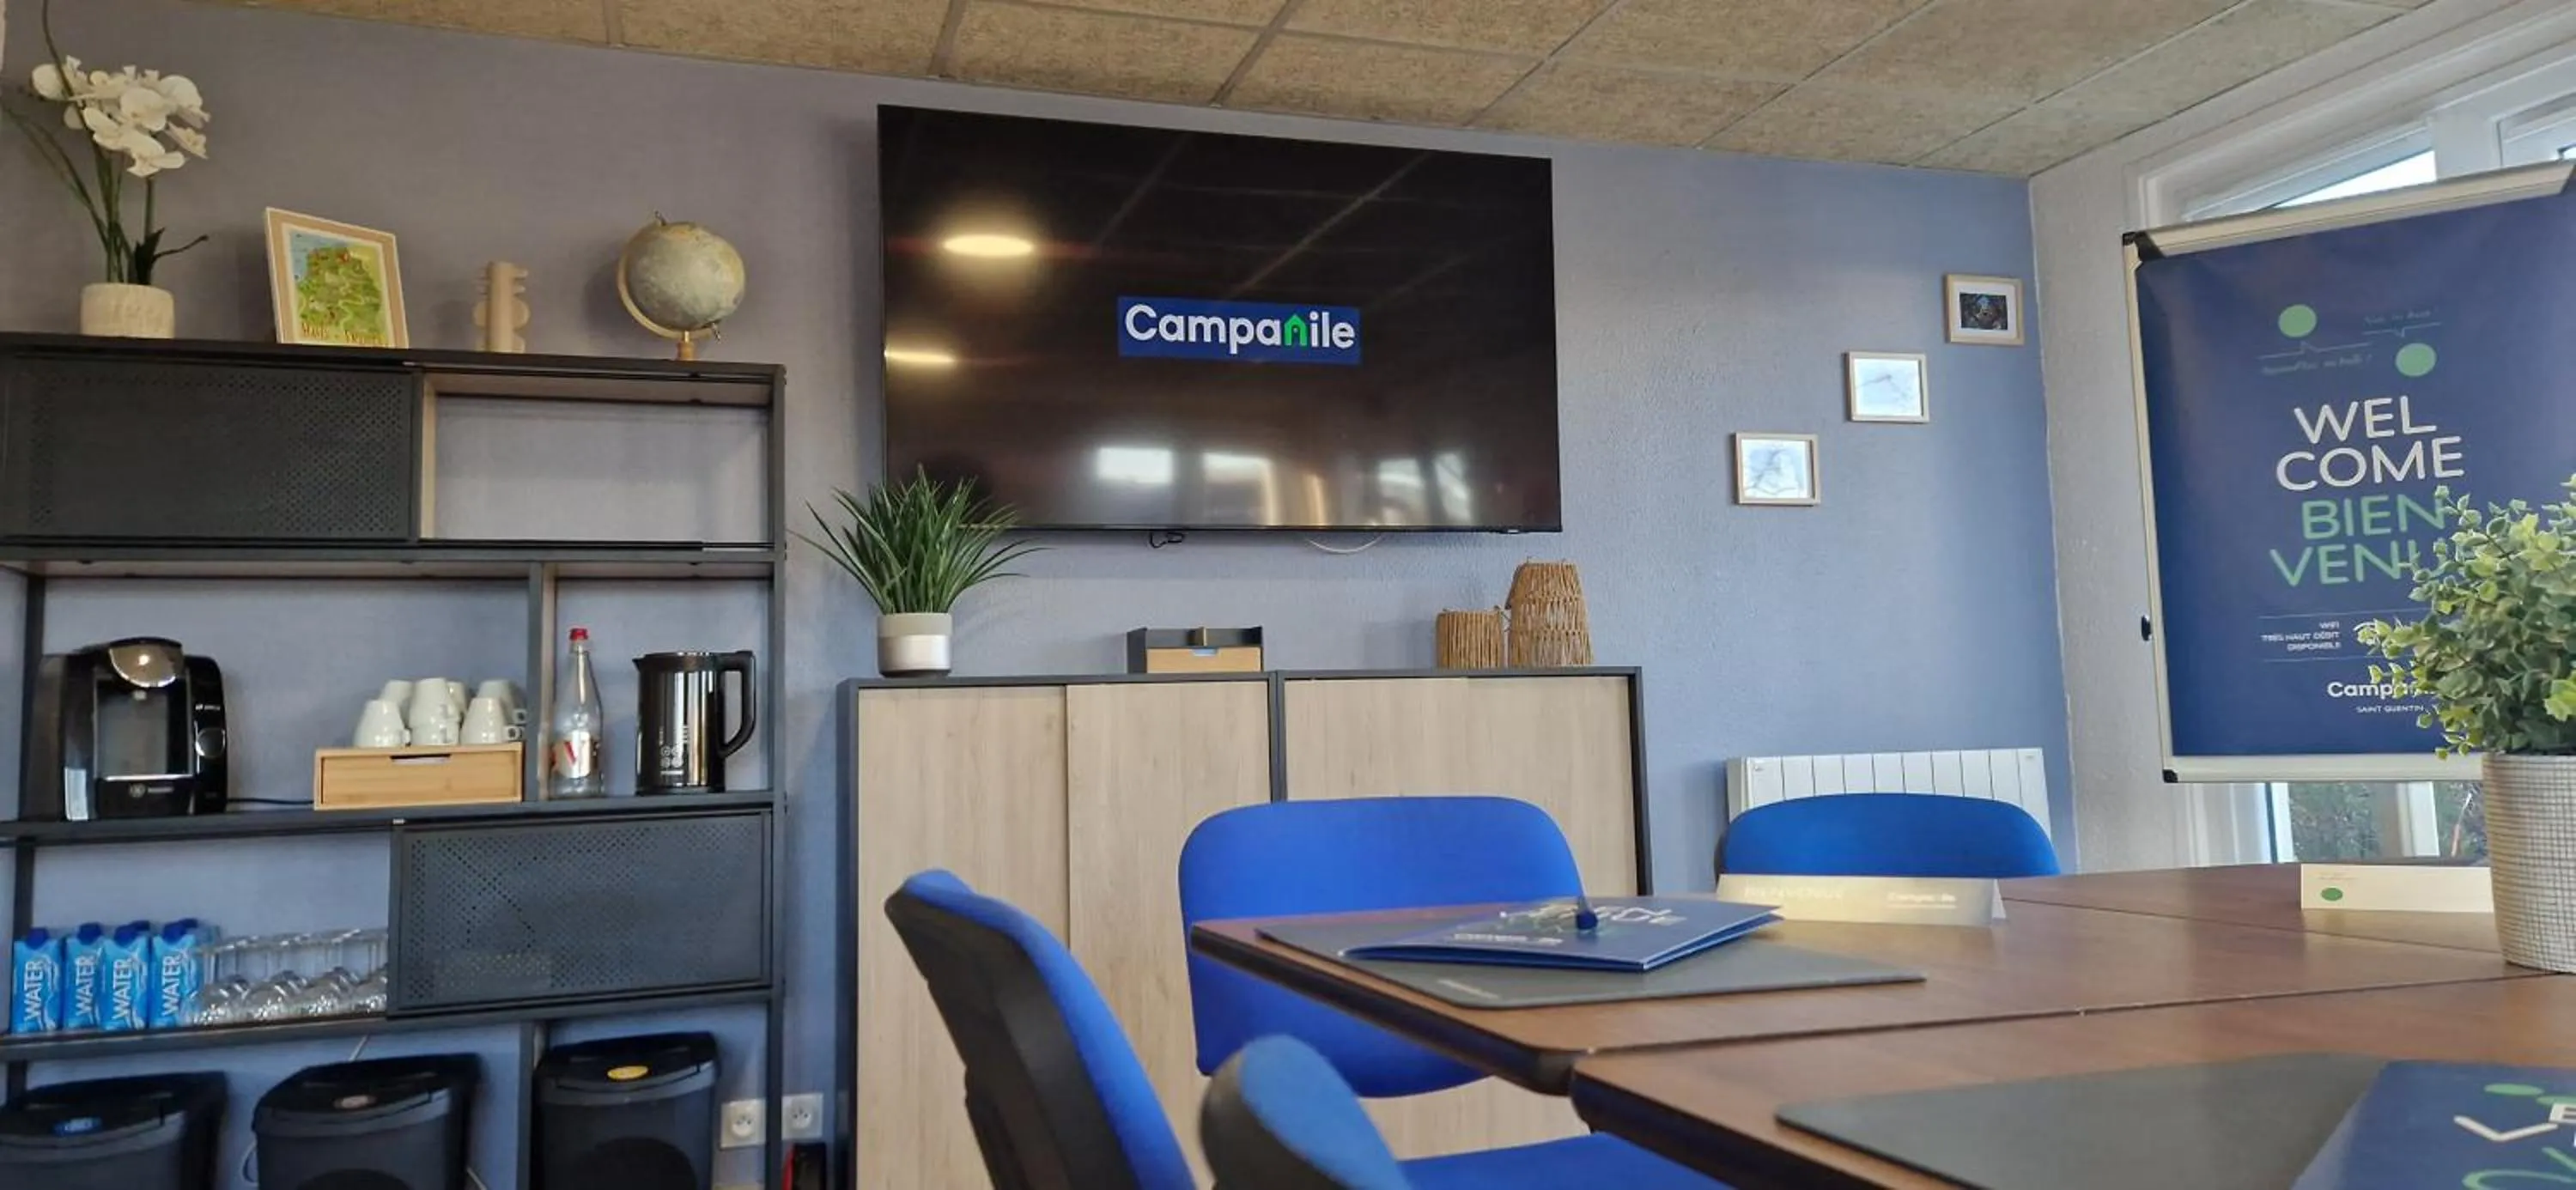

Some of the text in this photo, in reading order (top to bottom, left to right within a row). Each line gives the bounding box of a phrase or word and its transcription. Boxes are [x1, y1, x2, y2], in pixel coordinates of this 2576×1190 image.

[1125, 303, 1356, 355] Campanile
[2293, 395, 2438, 445] WEL
[2276, 435, 2464, 491] COME
[2301, 493, 2446, 540] BIEN
[2269, 538, 2447, 588] VENU
[24, 959, 44, 1022] WATER
[75, 956, 95, 1017] WATER
[112, 958, 132, 1020] WATER
[161, 955, 182, 1017] WATER
